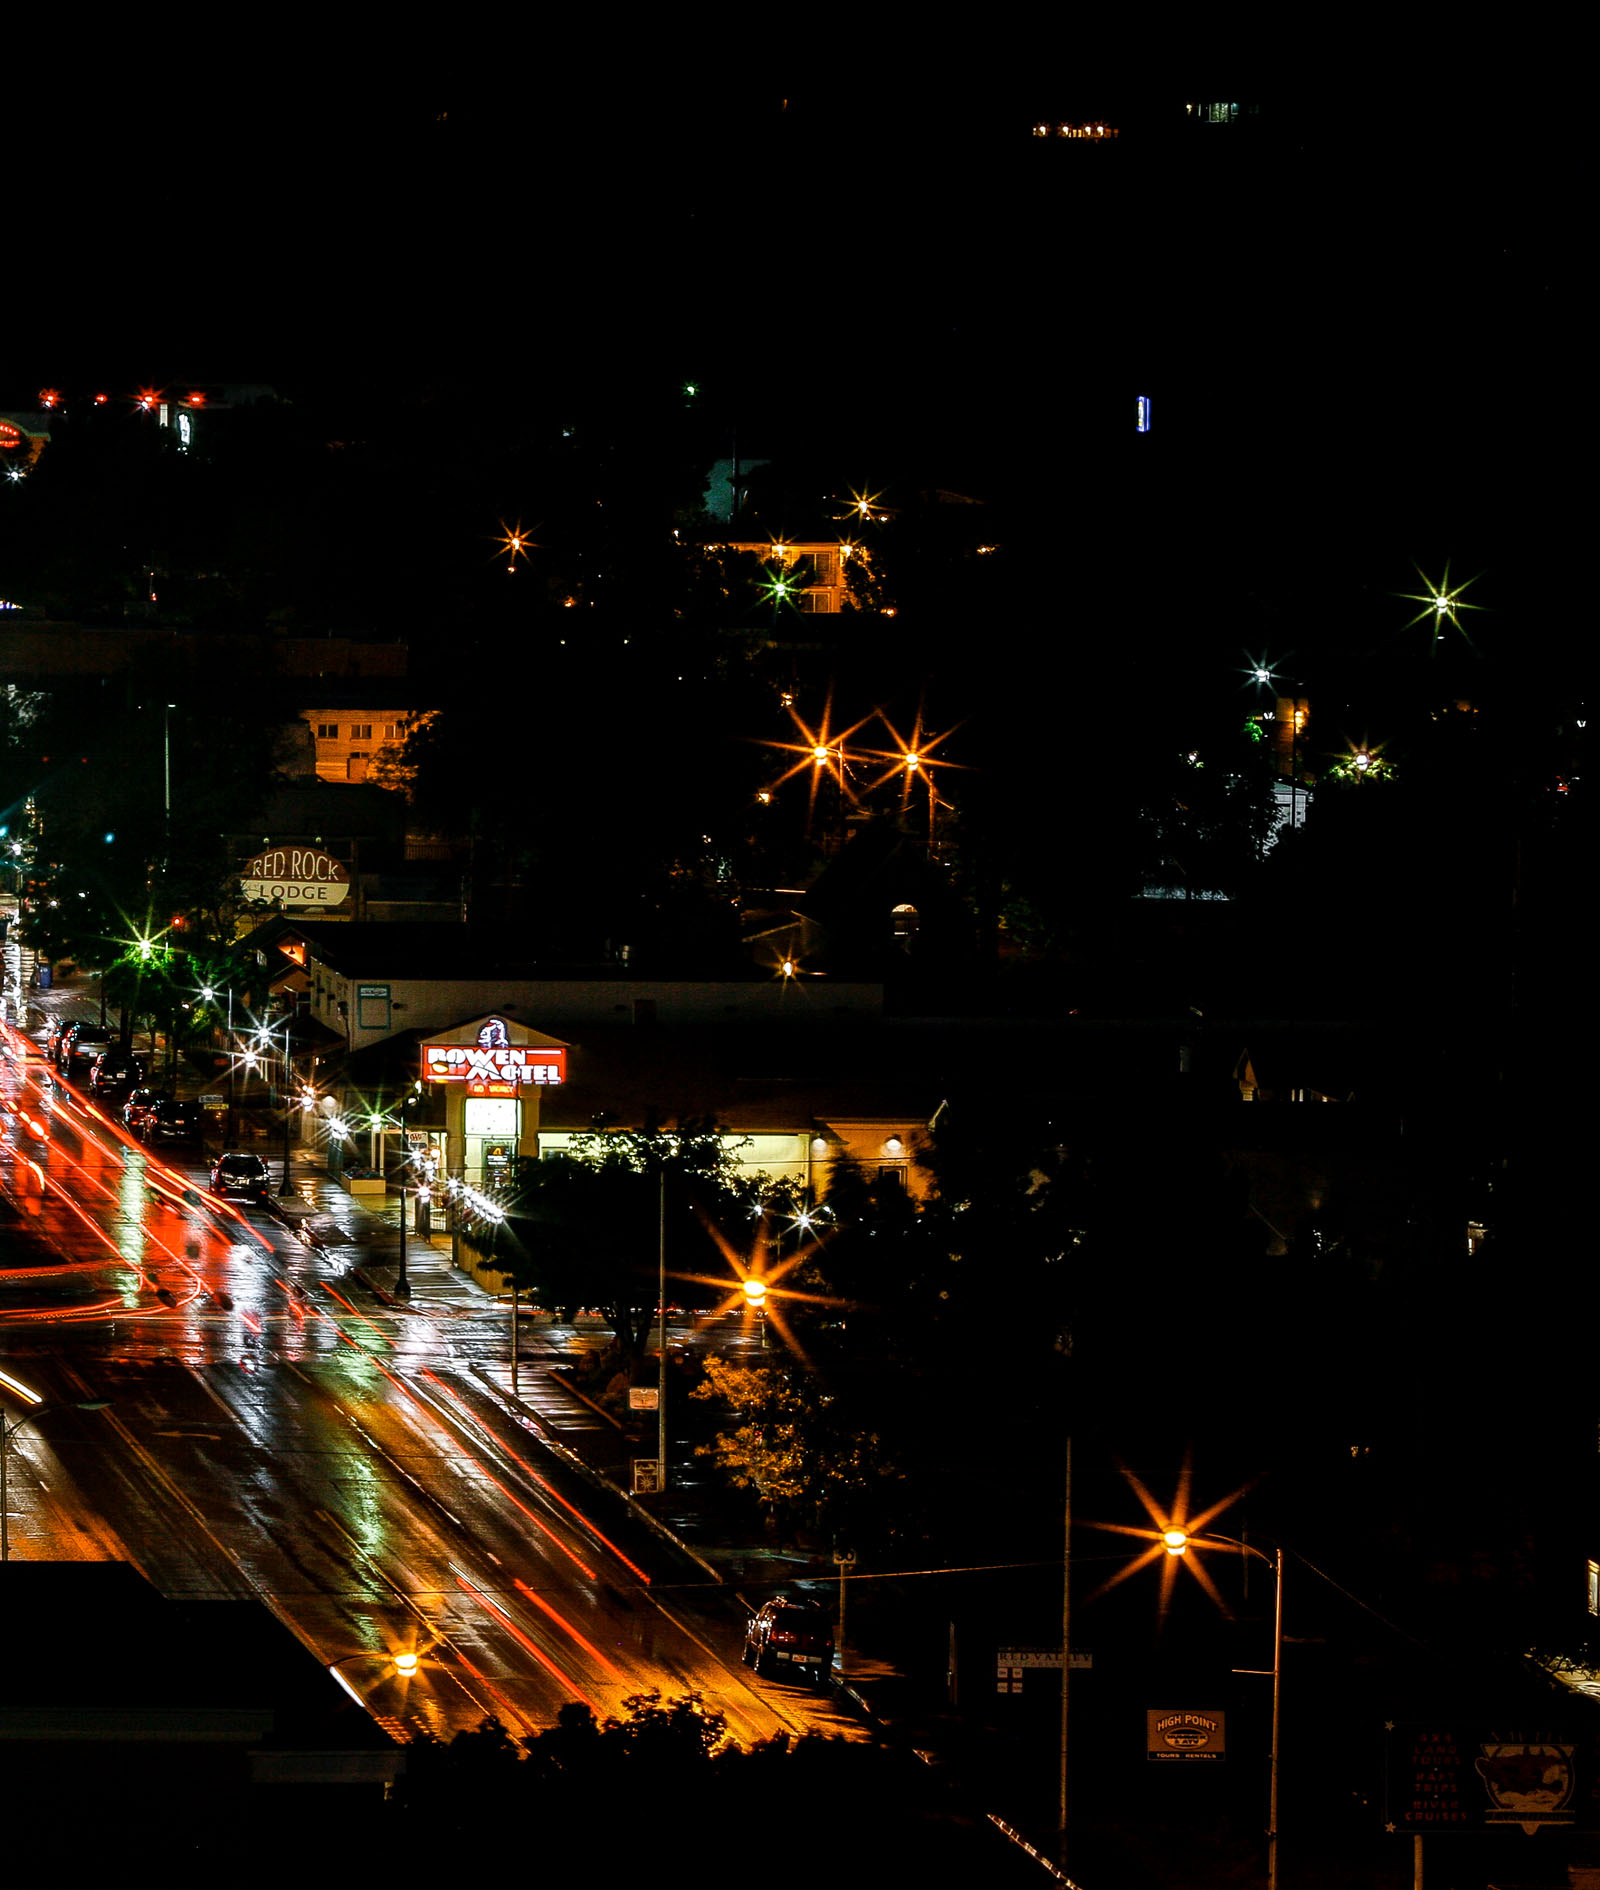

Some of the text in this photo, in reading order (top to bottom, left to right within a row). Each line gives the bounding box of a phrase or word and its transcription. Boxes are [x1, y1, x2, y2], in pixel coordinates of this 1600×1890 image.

[252, 850, 340, 881] RED ROCK
[259, 884, 328, 900] LODGE
[465, 1060, 562, 1081] MOTEL
[1033, 1652, 1091, 1661] VALEY
[1157, 1714, 1217, 1732] HIGH POINT
